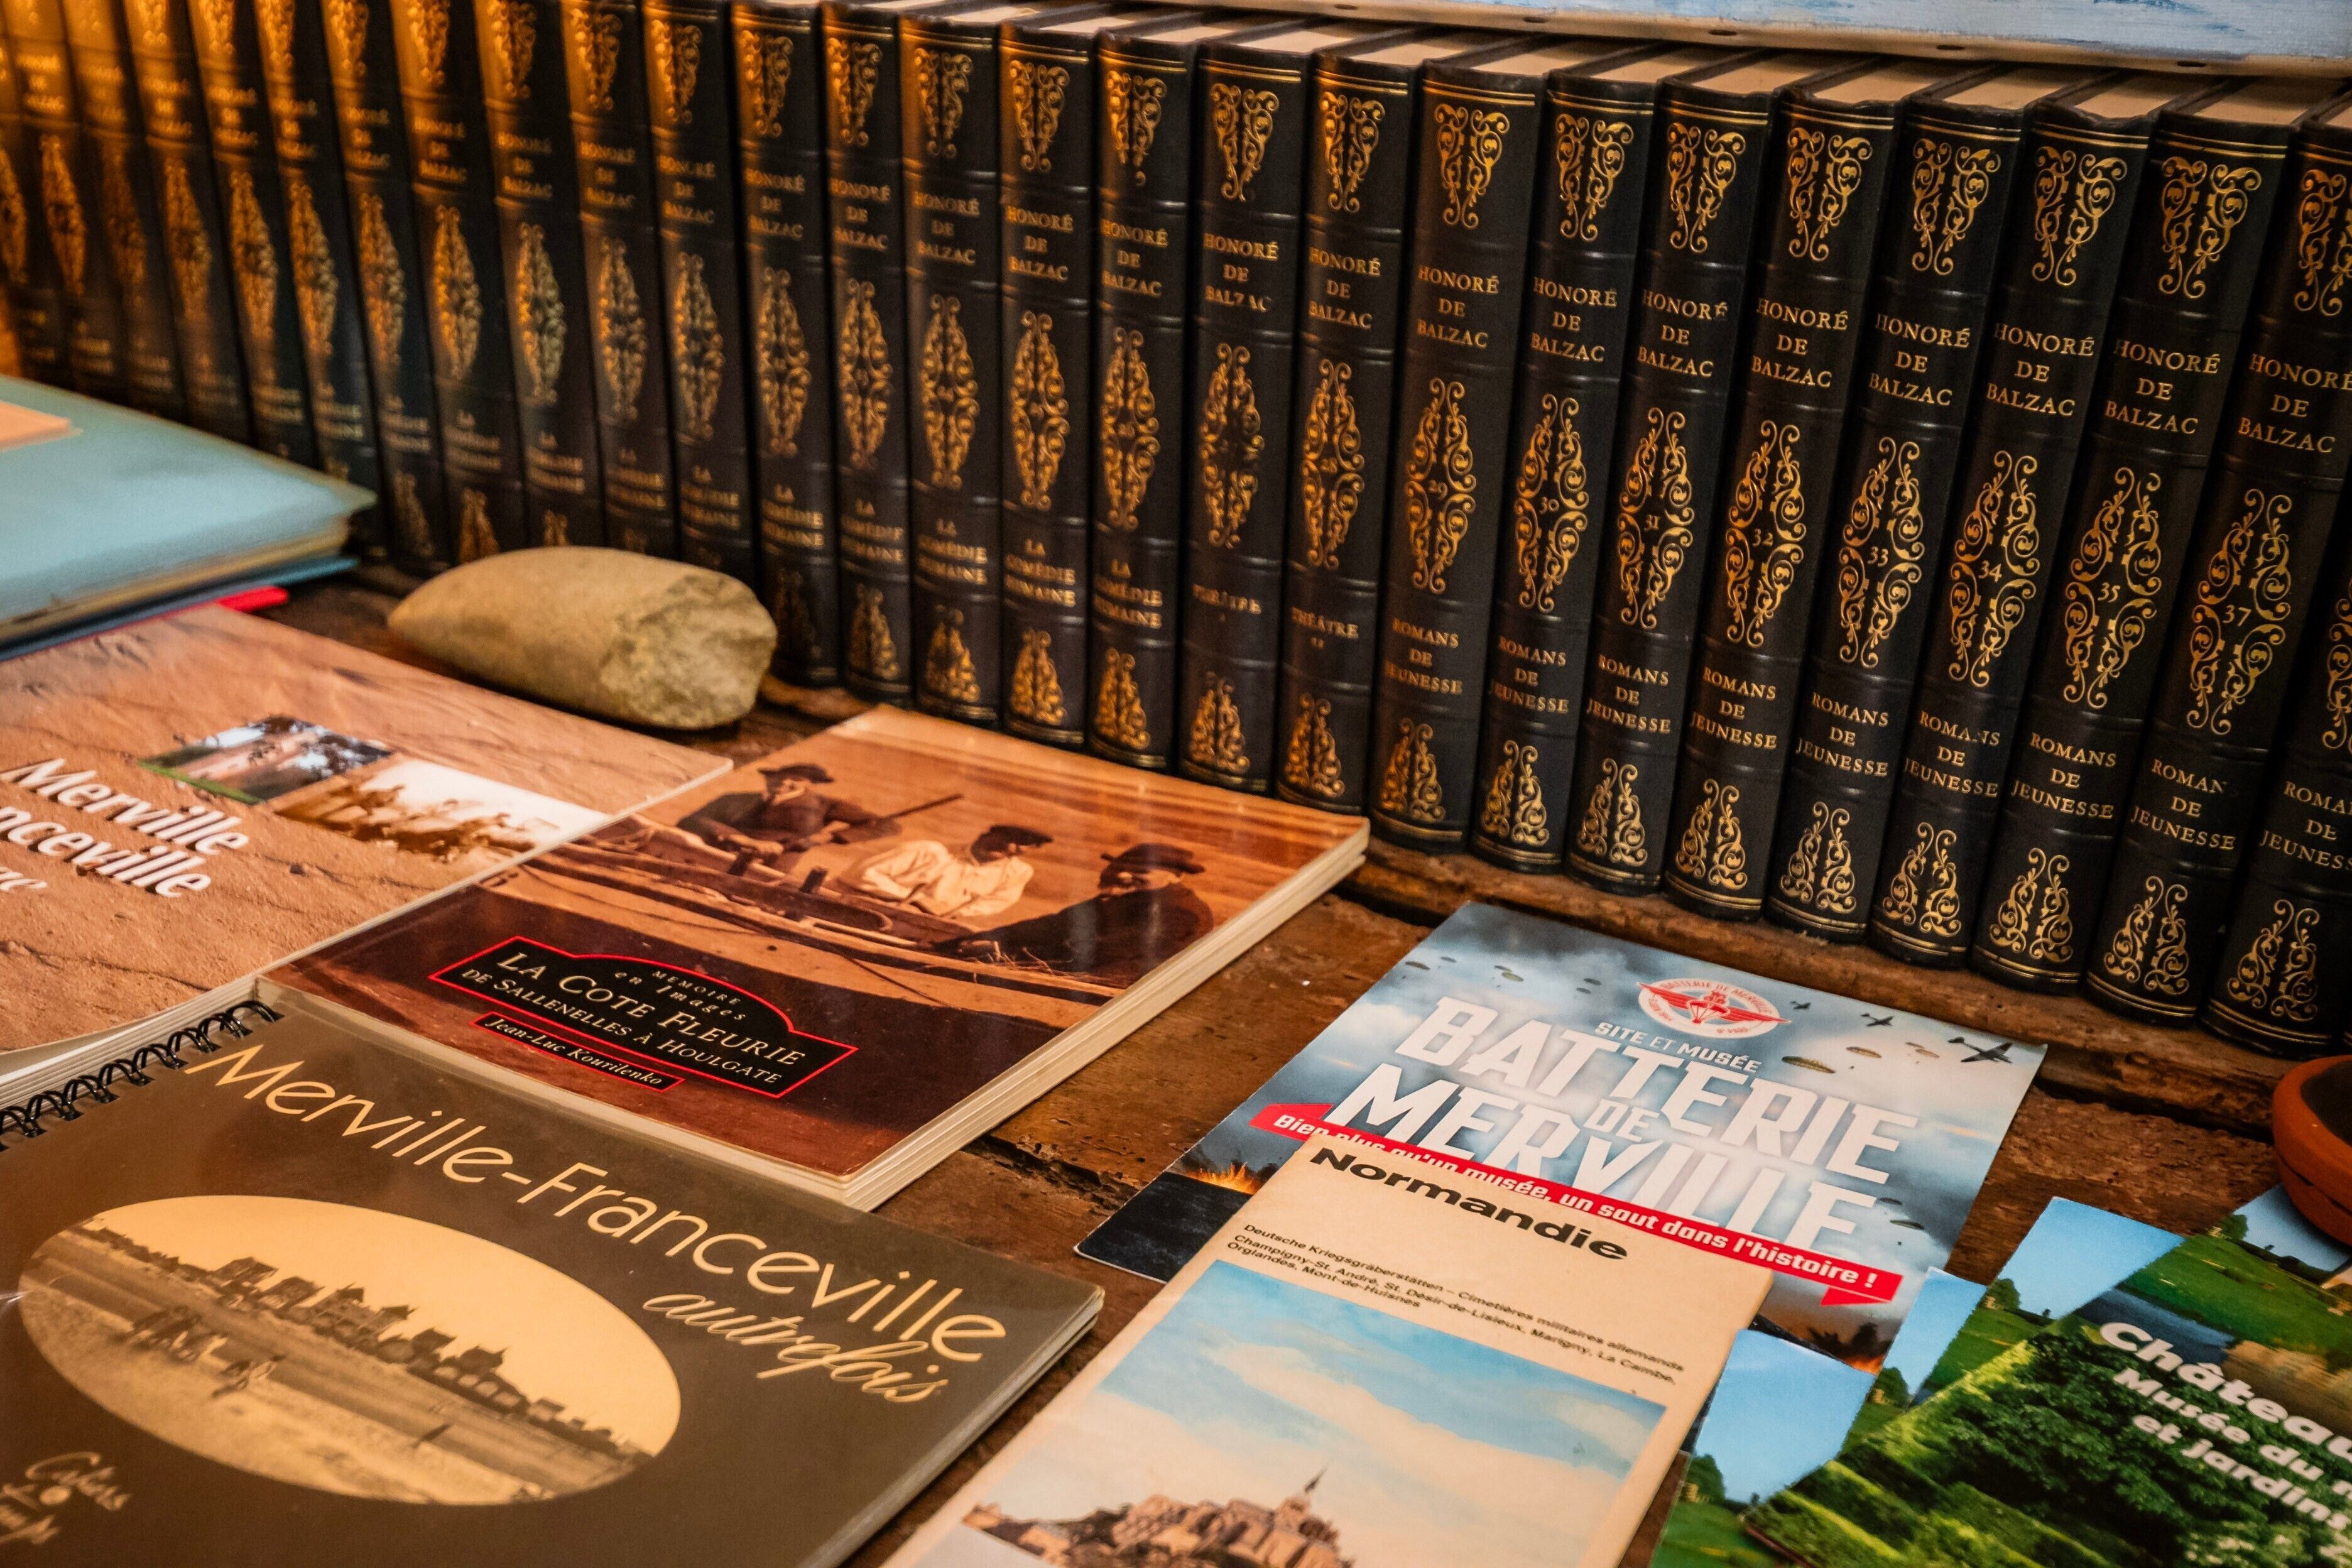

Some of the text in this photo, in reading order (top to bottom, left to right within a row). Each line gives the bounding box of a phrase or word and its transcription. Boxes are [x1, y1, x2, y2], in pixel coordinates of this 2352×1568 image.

[1005, 205, 1074, 233] HONORÉ
[1102, 219, 1167, 247] HONORÉ
[1024, 236, 1047, 253] DE
[1117, 249, 1140, 268] DE
[1204, 234, 1278, 261] HONORÉ
[1009, 256, 1069, 281] BALZAC
[1224, 264, 1248, 282] DE
[1310, 248, 1380, 276] HONORÉ
[1102, 271, 1162, 298] BALZAC
[1326, 280, 1349, 298] DE
[1418, 267, 1499, 293] HONORÉ
[1534, 278, 1617, 307] HONORÉ
[1309, 301, 1371, 329] BALZAC
[1439, 298, 1464, 317] DE
[1643, 290, 1728, 320] HONORÉ
[1757, 298, 1848, 331] HONORÉ
[1417, 320, 1488, 348] BALZAC
[1553, 312, 1581, 332] DE
[1662, 325, 1689, 345] DE
[1876, 315, 1970, 348] HONORÉ
[1532, 334, 1604, 362] BALZAC
[1777, 335, 1807, 355] DE
[1995, 324, 2094, 357] HONORÉ
[1638, 347, 1713, 377] BALZAC
[1897, 352, 1927, 373] DE
[2115, 339, 2221, 374] HONORÉ
[1753, 357, 1831, 388] BALZAC
[2015, 361, 2050, 383] DE
[1870, 373, 1952, 406] BALZAC
[1987, 384, 2076, 416] BALZAC
[2137, 378, 2173, 400] DE
[2106, 401, 2198, 434] BALZAC
[2271, 395, 2309, 418] DE
[2238, 417, 2336, 453] BALZAC
[1429, 479, 1448, 499] 29
[1540, 495, 1560, 512] 30
[1643, 514, 1660, 531] 31
[1026, 540, 1045, 556] LA
[1753, 528, 1773, 547] 32
[1112, 560, 1131, 577] LA
[1868, 545, 1889, 567] 33
[1978, 560, 2002, 582] 34
[2098, 581, 2121, 602] 35
[2223, 604, 2251, 627] 37
[1393, 619, 1458, 648] ROMANS
[1410, 649, 1432, 667] DE
[1499, 636, 1567, 667] ROMANS
[1515, 668, 1538, 686] DE
[1599, 655, 1669, 686] ROMANS
[1704, 667, 1776, 700] ROMANS
[1616, 687, 1639, 705] DE
[1721, 701, 1745, 719] DE
[1812, 694, 1888, 727] ROMANS
[1587, 699, 1671, 734] JEUNESSE
[1690, 712, 1777, 749] JEUNESSE
[1831, 727, 1856, 746] DE
[2031, 732, 2116, 767] ROMANS
[1796, 738, 1888, 777] JEUNESSE
[1938, 747, 1965, 766] DE
[1904, 758, 1998, 797] JEUNESSE
[2051, 769, 2079, 788] DE
[2152, 758, 2236, 795] ROMAN
[0, 758, 251, 856] Merville
[2012, 781, 2113, 819] JEUNESSE
[2172, 797, 2201, 817] DE
[2131, 807, 2235, 851] JEUNESSE
[2306, 820, 2336, 840] DE
[0, 805, 212, 898] nceville
[614, 971, 747, 1021] en Images
[652, 969, 741, 1005] MEMOIRE
[497, 951, 806, 1066] LA COTE FLEURIE
[461, 968, 783, 1084] DE SALLENELLES À HOULGATE
[484, 1018, 663, 1086] Jean-Luc Kourilenko
[1594, 1021, 1763, 1074] SITE ET MUSÉE
[1394, 996, 1919, 1184] BATTERIE
[1582, 1099, 1660, 1143] DE
[1322, 1062, 1880, 1253] MERVILLE
[184, 1043, 1006, 1362] Merville-Franceville
[1273, 1114, 1330, 1136] Bien
[1461, 1167, 1553, 1202] musée,
[1559, 1193, 1595, 1212] un
[1597, 1204, 1660, 1230] saut
[1661, 1219, 1729, 1250] dans
[1732, 1237, 1861, 1284] l'histoire
[1864, 1271, 1879, 1288] !
[1309, 1146, 1628, 1261] Normandie
[1227, 1241, 1422, 1309] Orglandes, Mont-de-Huisnes
[1244, 1224, 1307, 1250] Deutsche
[1308, 1243, 1444, 1292] Kriegsgräberstätten
[1458, 1290, 1534, 1321] Cimetières
[1536, 1317, 1604, 1344] militaires
[1607, 1341, 1685, 1373] allemands
[642, 1293, 949, 1403] autrefois
[2113, 1366, 2325, 1481] Musée du
[2133, 1413, 2184, 1445] et
[2182, 1438, 2351, 1531] jardins
